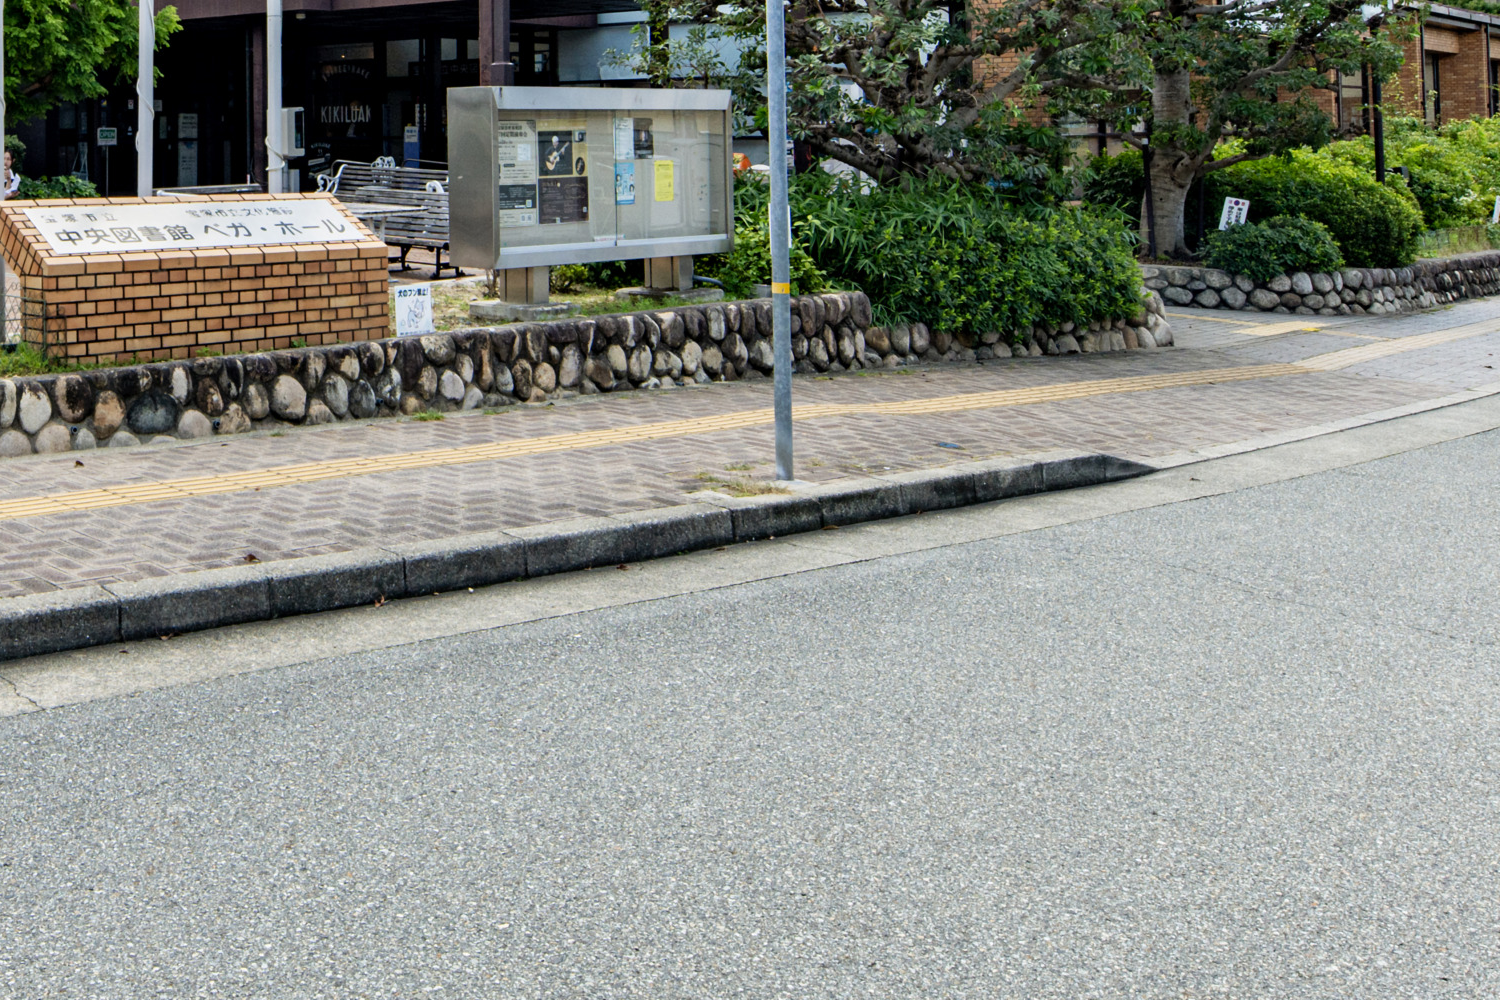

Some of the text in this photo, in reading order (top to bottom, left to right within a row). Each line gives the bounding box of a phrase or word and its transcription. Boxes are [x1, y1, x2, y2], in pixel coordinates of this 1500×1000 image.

[55, 218, 346, 246] 中央図書館 ベガ・ホール
